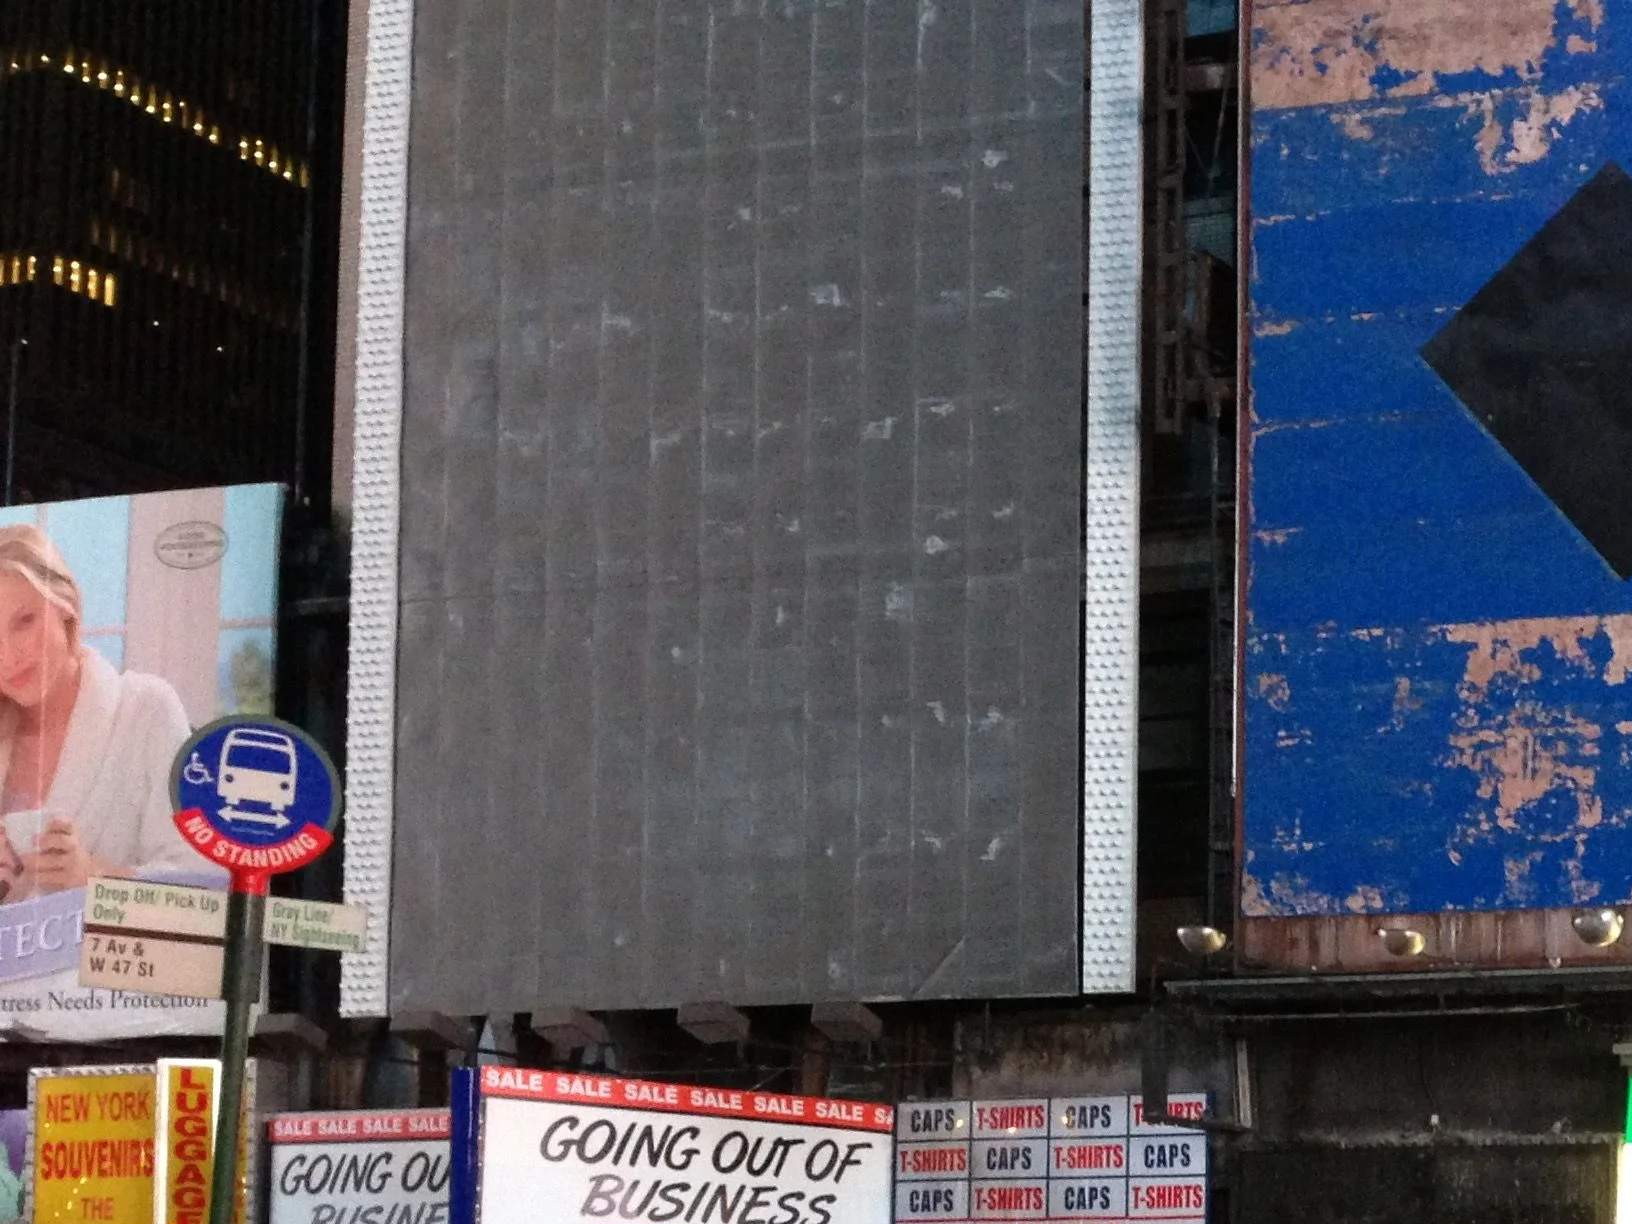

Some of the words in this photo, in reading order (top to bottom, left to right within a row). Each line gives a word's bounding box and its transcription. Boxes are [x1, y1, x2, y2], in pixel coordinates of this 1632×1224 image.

[185, 816, 213, 844] NO
[213, 832, 318, 867] STANDING
[94, 884, 128, 902] Drop
[166, 891, 194, 907] Pick
[200, 896, 220, 912] Up
[93, 904, 124, 923] Only
[90, 938, 99, 951] 7
[106, 940, 127, 954] Av
[133, 944, 144, 956] &
[90, 957, 106, 972] W
[112, 960, 131, 974] 47
[138, 962, 154, 977] St
[48, 991, 102, 1010] Needs
[110, 990, 208, 1010] Protection
[46, 1094, 90, 1122] NEW
[96, 1091, 150, 1121] YORK
[486, 1070, 543, 1092] SALE
[556, 1077, 611, 1098] SALE
[624, 1083, 678, 1104] SALE
[690, 1090, 743, 1110] SALE
[754, 1096, 804, 1116] SALE
[816, 1102, 864, 1122] SALE
[273, 1121, 312, 1136] SALE
[319, 1118, 356, 1134] SALE
[363, 1118, 402, 1133] SALE
[408, 1116, 449, 1132] SALE
[910, 1108, 955, 1132] CAPS
[977, 1106, 1044, 1130] T-SHIRTS
[1065, 1104, 1110, 1128] CAPS
[1133, 1102, 1204, 1127] TIRTS
[41, 1139, 154, 1180] SOUVENIRS
[540, 1115, 700, 1171] GOING
[712, 1130, 804, 1179] OUT
[805, 1138, 873, 1184] OF
[900, 1148, 966, 1172] T-SHIRTS
[986, 1147, 1032, 1170] CAPS
[1054, 1144, 1124, 1169] T-SHIRTS
[1144, 1144, 1191, 1168] CAPS
[280, 1152, 393, 1196] GOING
[401, 1151, 450, 1193] OU
[80, 1197, 114, 1220] THE
[909, 1188, 954, 1212] CAPS
[976, 1187, 1043, 1210] T-SHIRTS
[1064, 1186, 1110, 1210] CAPS
[1133, 1184, 1202, 1209] T-SHIRTS
